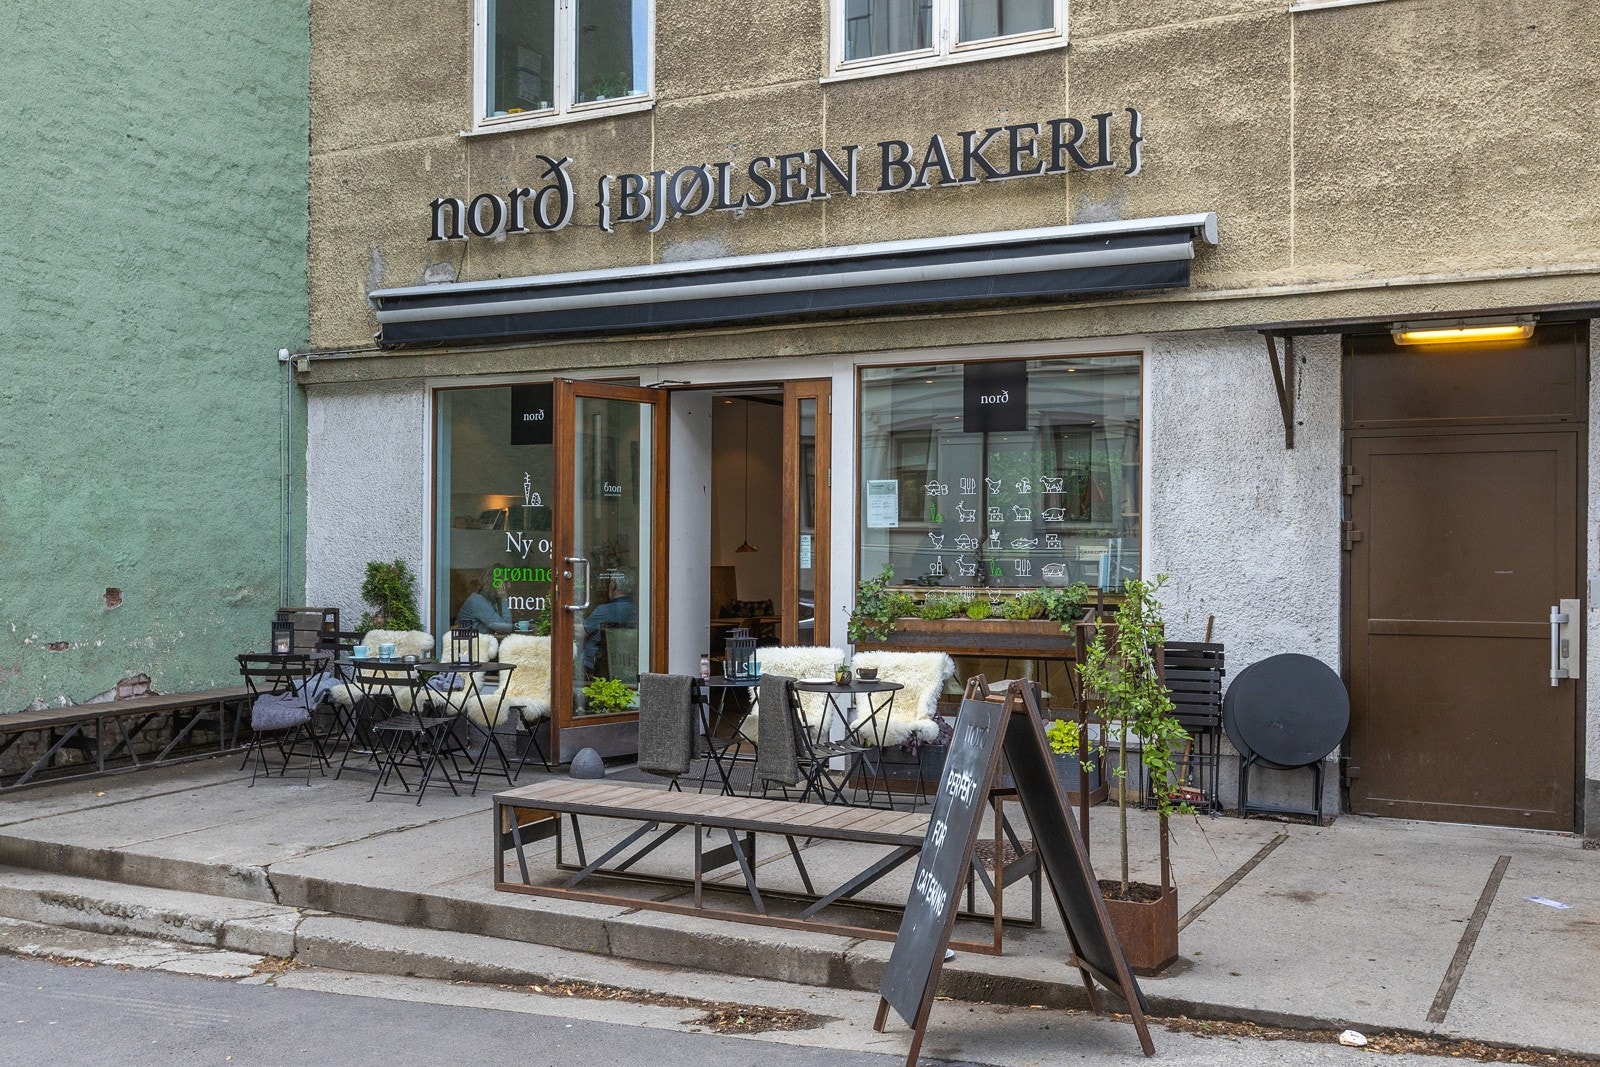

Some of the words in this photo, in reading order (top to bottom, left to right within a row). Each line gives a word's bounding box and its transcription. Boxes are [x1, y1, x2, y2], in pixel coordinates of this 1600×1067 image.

[427, 155, 573, 241] norð
[981, 389, 1009, 404] norð
[523, 408, 545, 421] norð
[505, 532, 533, 559] Ny
[508, 595, 551, 611] men
[945, 769, 978, 807] PERFEKT
[931, 819, 948, 847] FOR
[915, 868, 947, 917] CATERING
